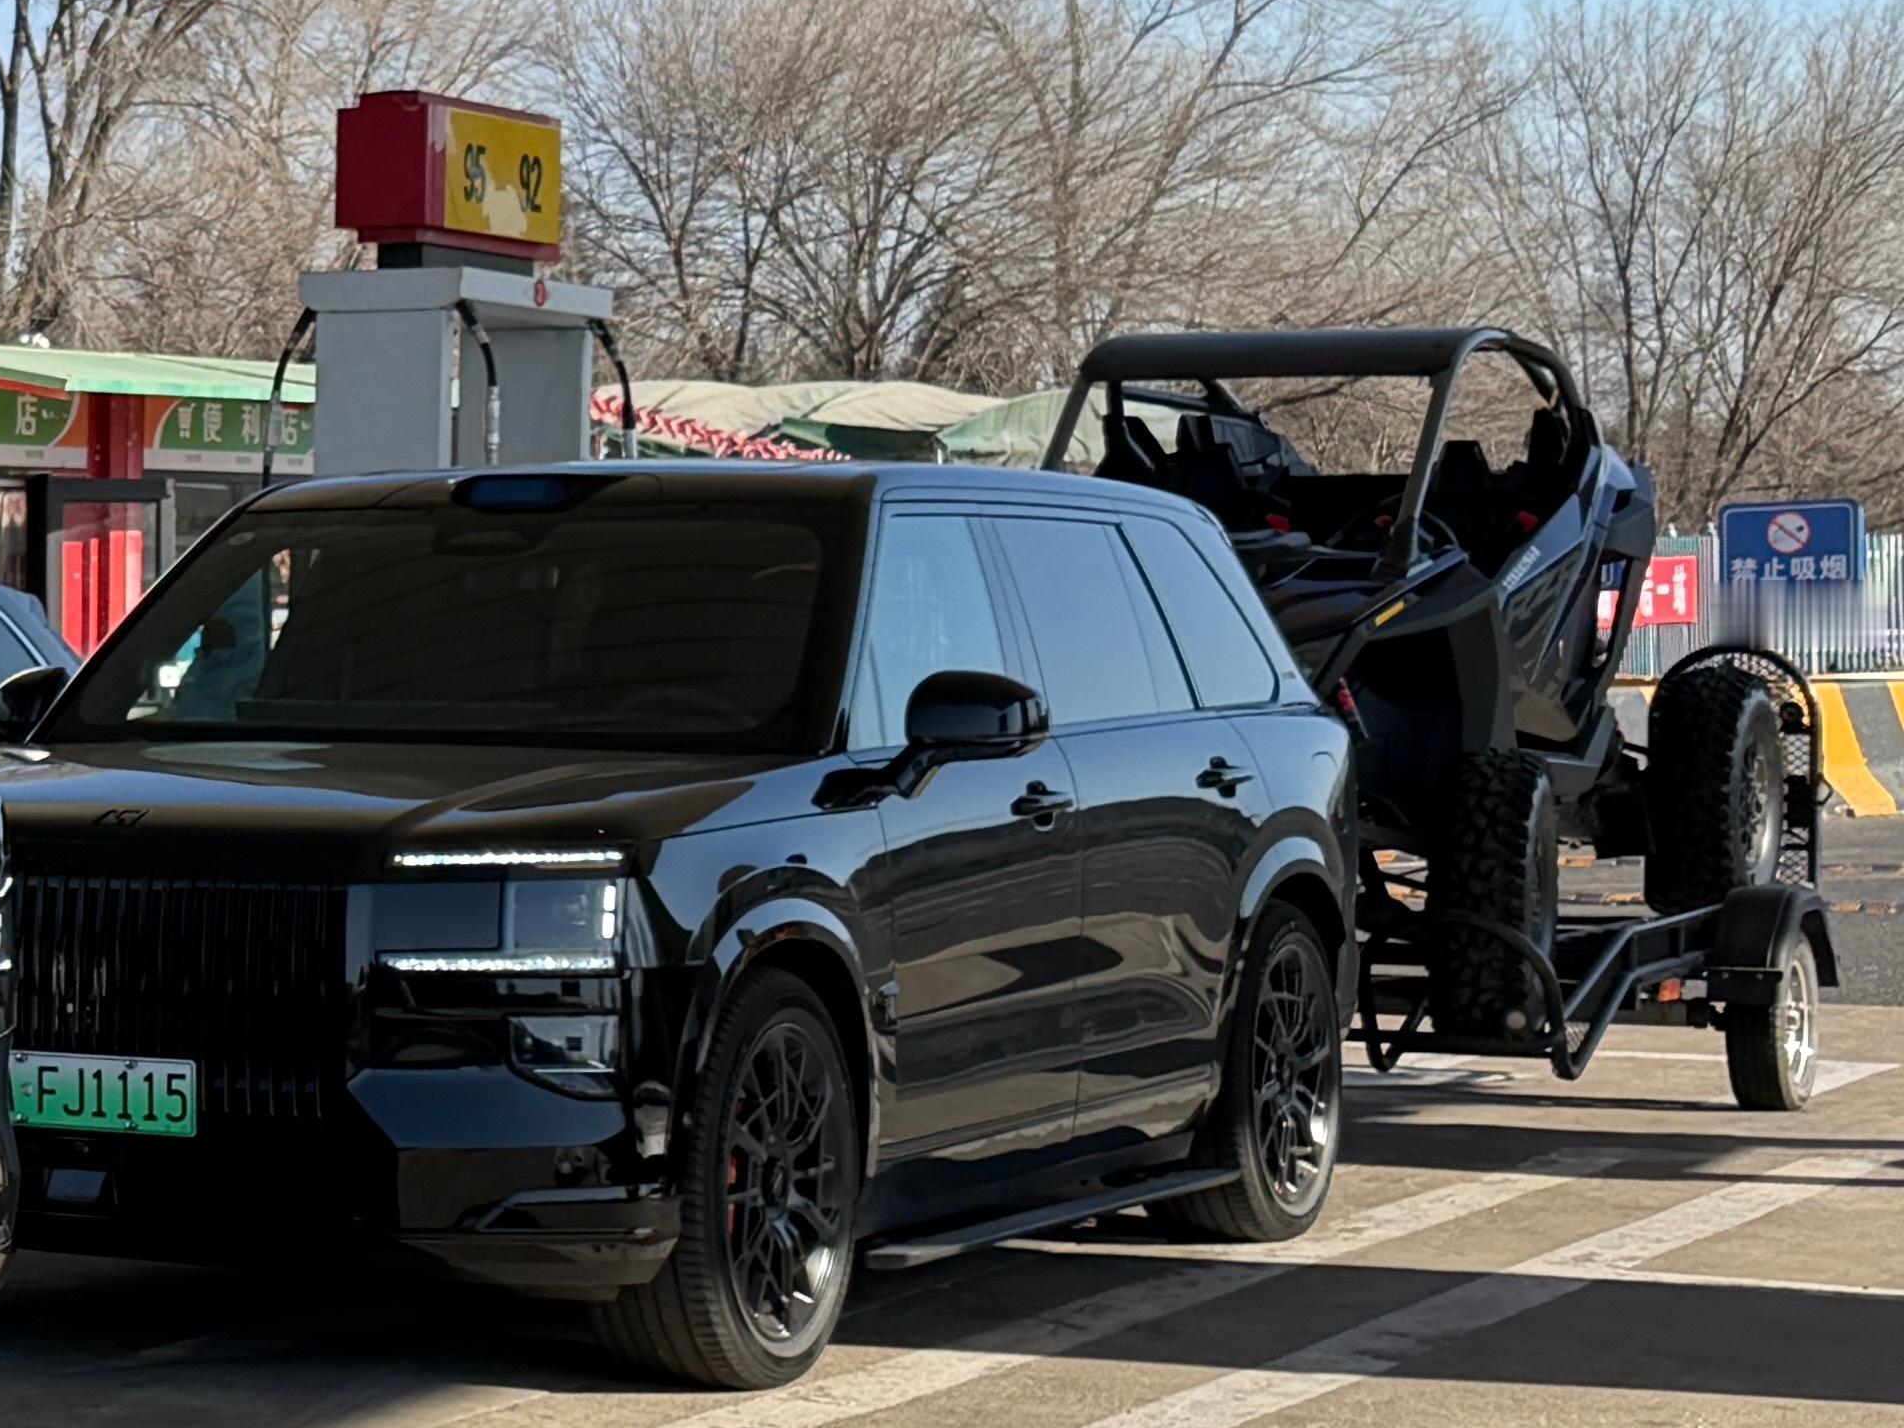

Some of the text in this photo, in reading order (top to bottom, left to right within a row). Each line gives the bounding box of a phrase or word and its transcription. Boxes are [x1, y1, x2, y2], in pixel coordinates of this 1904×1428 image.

[463, 143, 542, 213] 95 92
[202, 403, 298, 445] 便利店
[1731, 554, 1848, 581] 禁止吸烟
[37, 1066, 188, 1123] FJ1115
